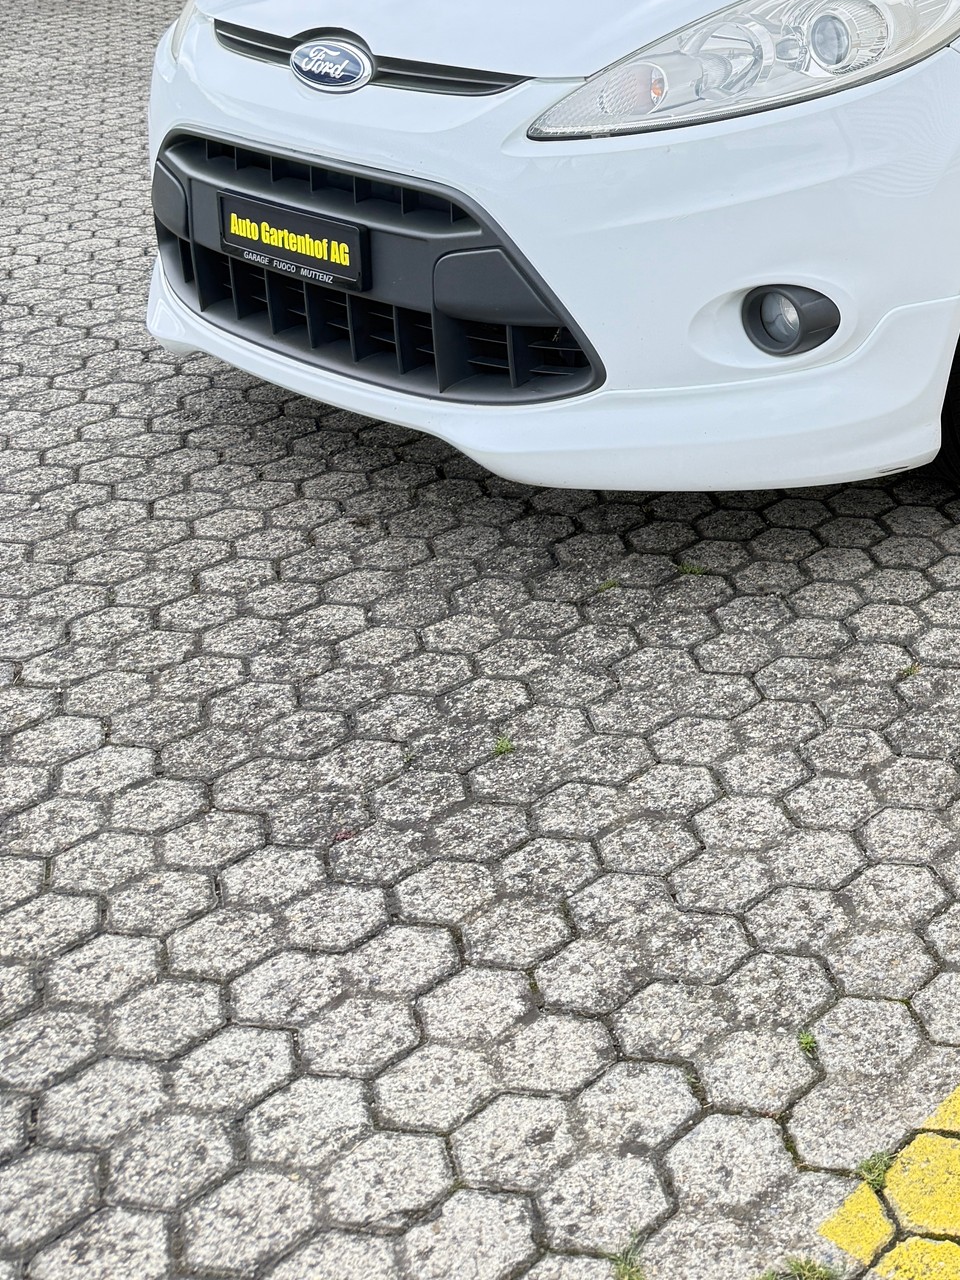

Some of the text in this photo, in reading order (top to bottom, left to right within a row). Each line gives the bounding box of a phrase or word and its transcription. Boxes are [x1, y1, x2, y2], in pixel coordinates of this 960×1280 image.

[301, 46, 350, 79] Ford
[230, 212, 350, 267] Auto Gartenhof AG
[243, 251, 334, 284] GARAGE FUOCO MUTTENZ
